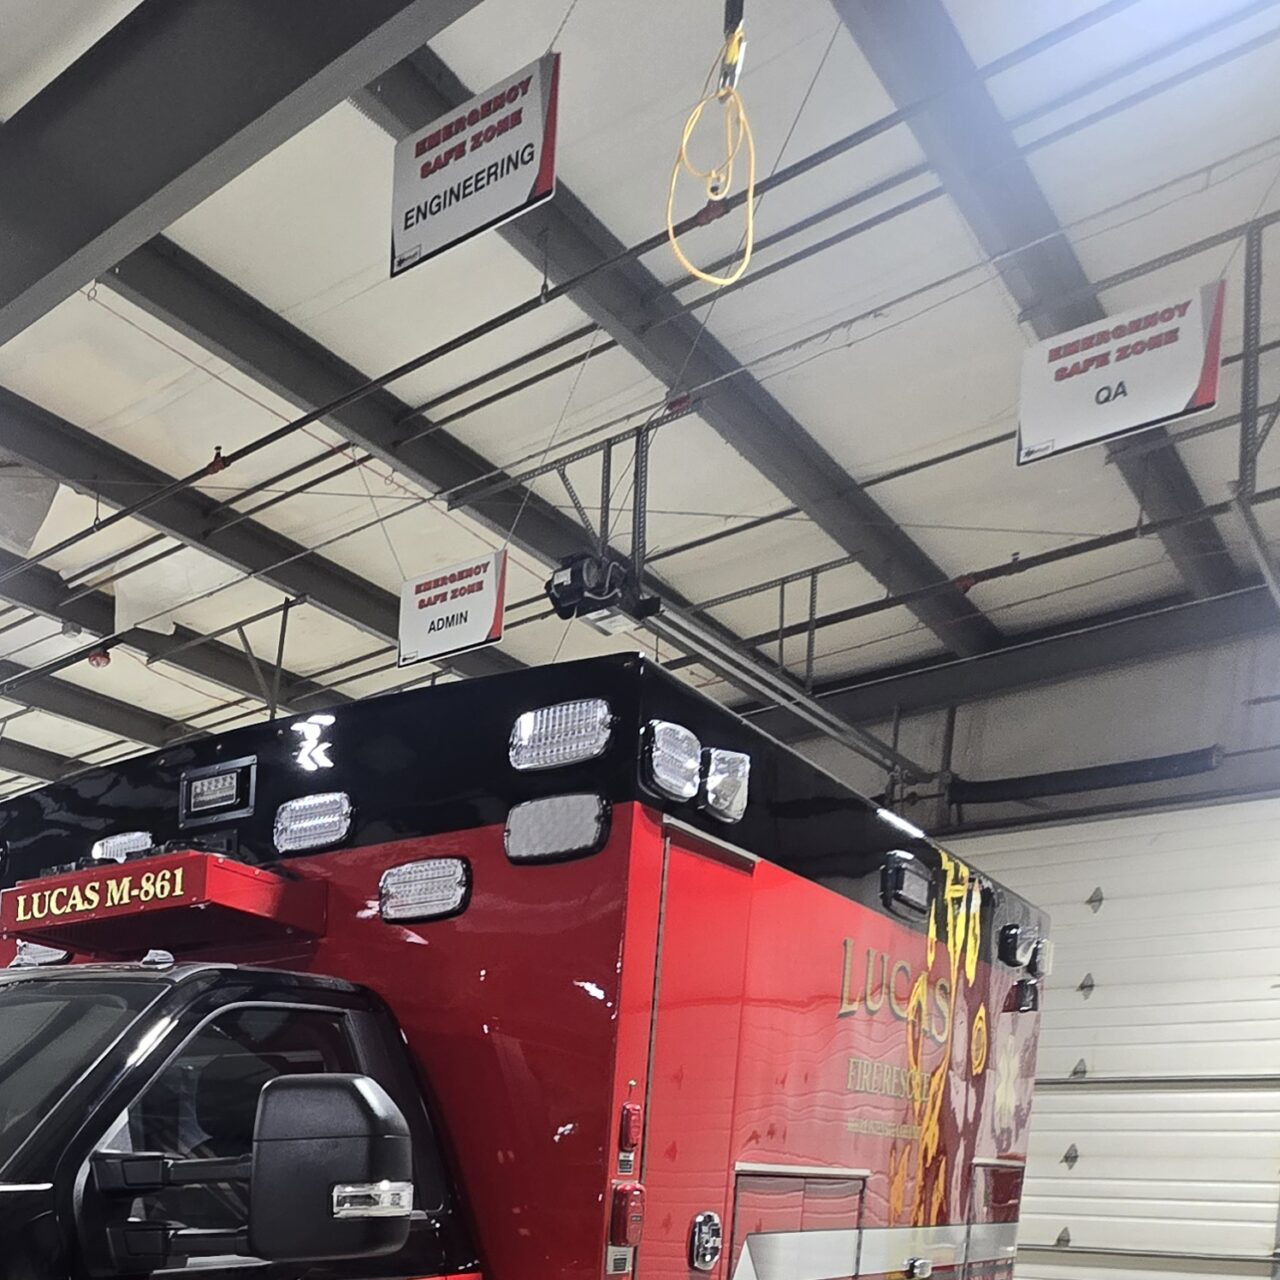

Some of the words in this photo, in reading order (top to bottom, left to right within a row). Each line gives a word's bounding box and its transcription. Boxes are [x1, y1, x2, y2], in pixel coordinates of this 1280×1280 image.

[415, 75, 533, 158] EMERGENCY
[420, 140, 467, 180] SAFE
[470, 107, 524, 152] ZONE
[404, 142, 535, 231] ENGINEERING
[1047, 299, 1193, 363] EMERGENCY
[1054, 351, 1111, 382] SAFE
[1115, 327, 1181, 362] ZONE
[1094, 381, 1128, 406] QA
[414, 561, 491, 595] EMERGENCY
[417, 591, 449, 610] SAFE
[450, 579, 484, 600] ZONE
[427, 610, 469, 634] ADMIN
[16, 882, 100, 921] LUCAS
[105, 867, 185, 907] M-861
[837, 936, 951, 1047] LUCAS
